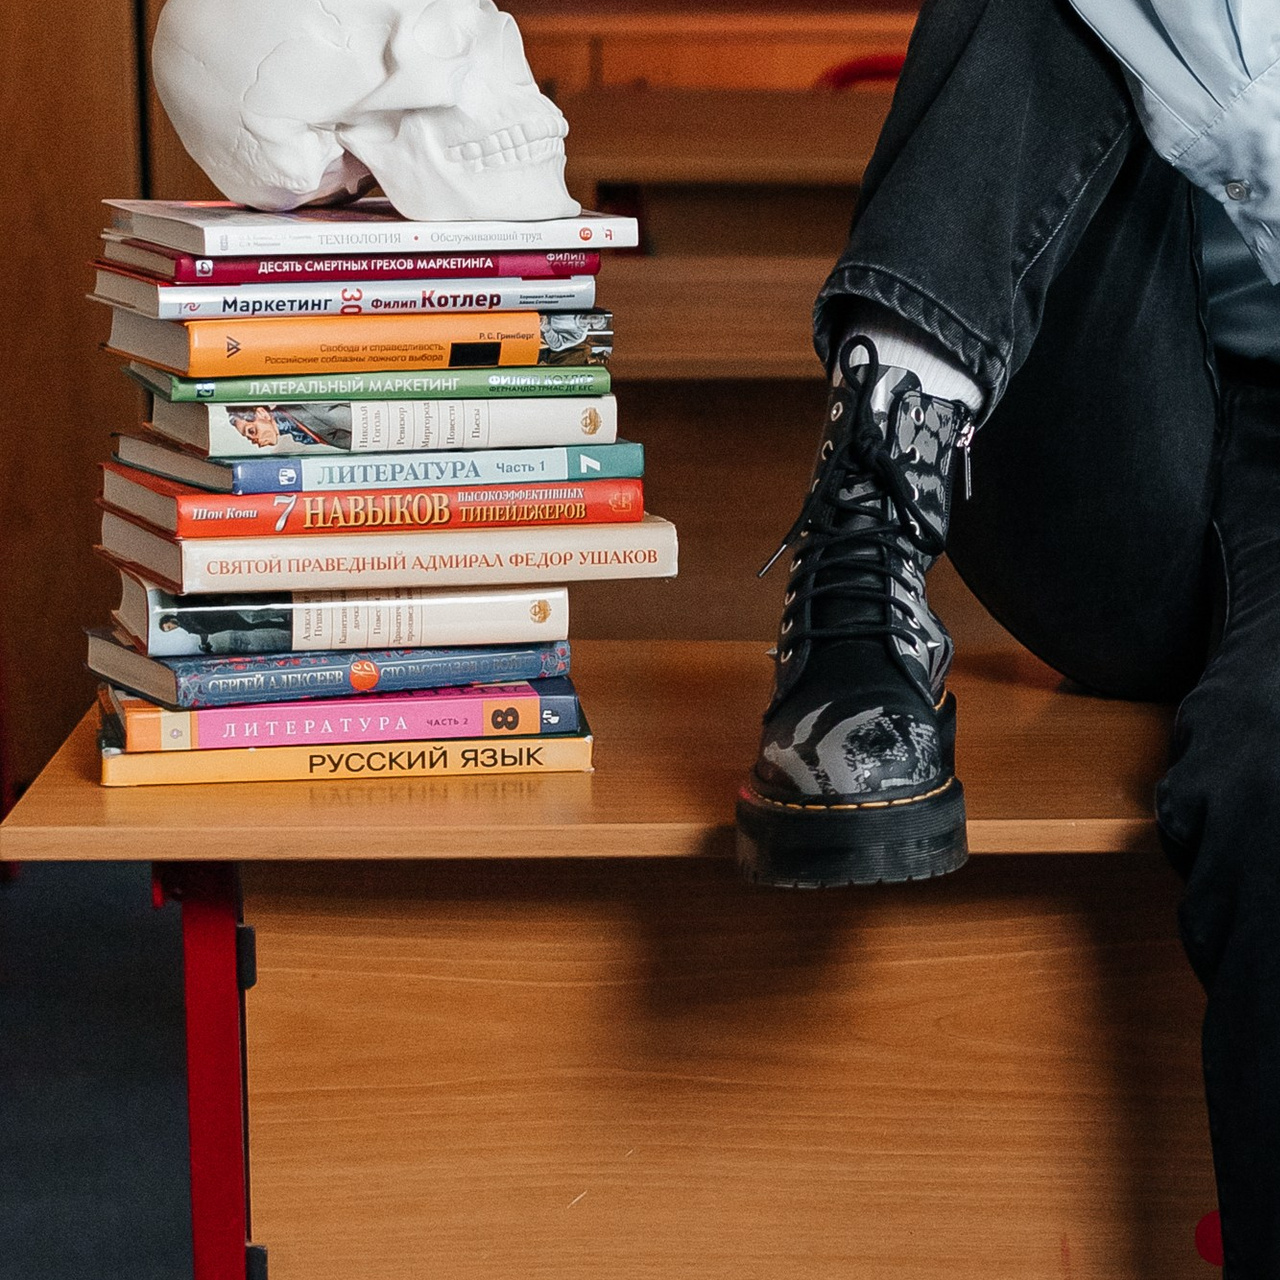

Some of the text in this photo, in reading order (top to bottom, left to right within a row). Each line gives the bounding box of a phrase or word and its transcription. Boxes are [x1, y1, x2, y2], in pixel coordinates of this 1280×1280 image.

[318, 232, 401, 245] ТЕХНОЛОГИЯ
[430, 230, 518, 244] Обслуживающий
[521, 231, 543, 242] труд
[258, 257, 494, 274] ДЕСЯТЬ СМЕРТНЫХ ГРЕХОВ МАРКЕТИНГА
[546, 252, 586, 261] ФИЛИП
[222, 296, 333, 315] Маркетинг
[371, 290, 502, 310] Филип Котлер
[496, 332, 535, 341] Гринберг
[320, 343, 360, 353] Свобода
[361, 344, 368, 352] и
[264, 353, 443, 365] Российские соблазны ложного выбора
[248, 376, 460, 395] ЛАТЕРАЛЬНЫЙ МАРКЕТИНГ
[488, 385, 537, 393] ФЕРНАНДО
[396, 406, 408, 446] Ревизор
[421, 401, 433, 448] Миргород
[446, 405, 455, 445] Повести
[471, 408, 480, 439] Пьесы
[317, 460, 545, 486] ЛИТЕРАТУРА Часть 1
[457, 488, 585, 503] ВЫСОКОЭФФЕКТИВНЫХ
[192, 506, 258, 520] Шон Кови
[272, 492, 450, 532] 7 НАВЫКОВ
[459, 501, 587, 522] ТИНЕЙДЖЕРОВ
[205, 549, 658, 575] СВЯТОЙ ПРАВЕДНЫЙ АДМИРАЛ ФЕДОР УШАКОВ
[208, 670, 343, 693] СЕРГЕЙ АЛЕКСЕЕВ
[380, 665, 406, 680] СТО
[222, 716, 469, 738] ЛИТЕРАТУРА ЧАСТЬ 2
[491, 707, 520, 730] 8
[308, 746, 545, 774] РУССКИЙ ЯЗЫК
